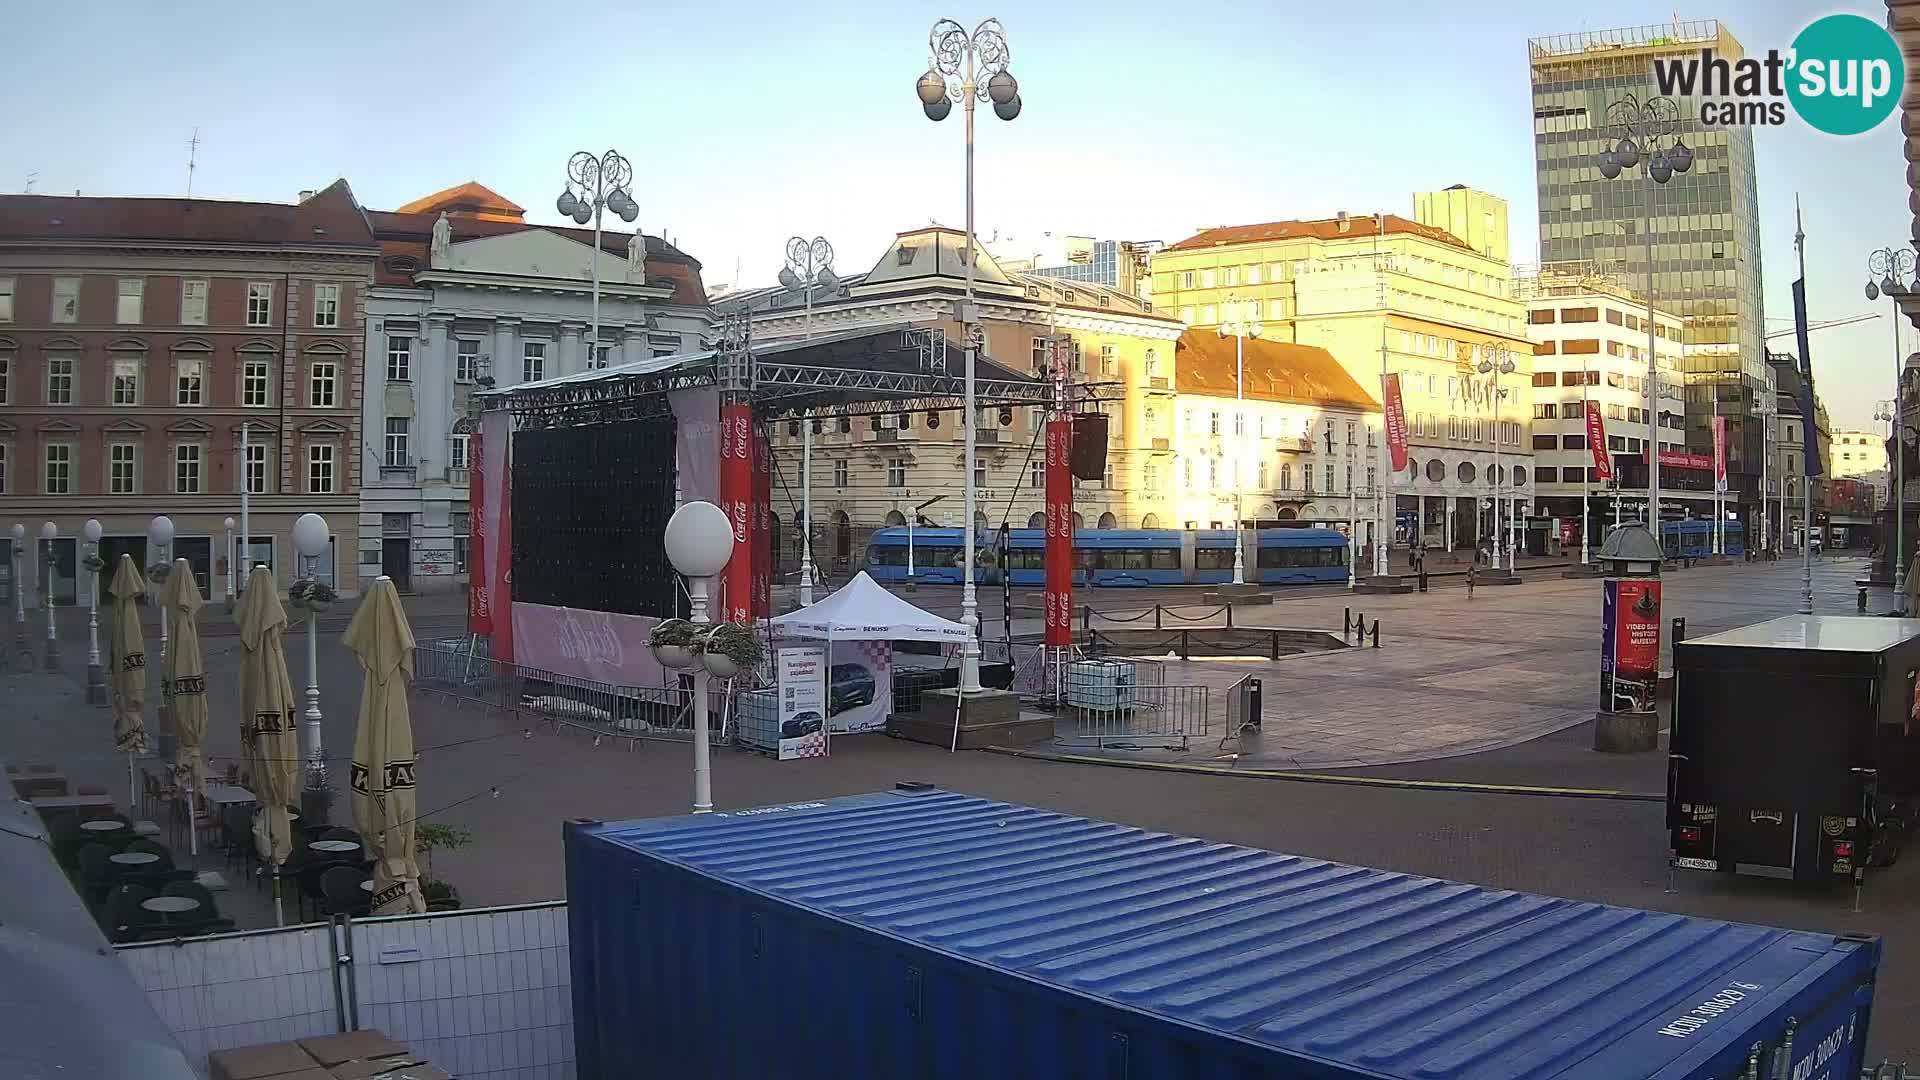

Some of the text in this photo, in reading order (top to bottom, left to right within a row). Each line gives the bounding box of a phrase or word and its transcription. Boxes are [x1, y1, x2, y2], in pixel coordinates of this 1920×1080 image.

[735, 416, 747, 459] Coca-Cola
[735, 501, 747, 543] Coca-Cola
[1059, 503, 1069, 538] Coca-Cola
[1059, 592, 1069, 627] Coca-Cola
[1692, 988, 1745, 1018] 300629
